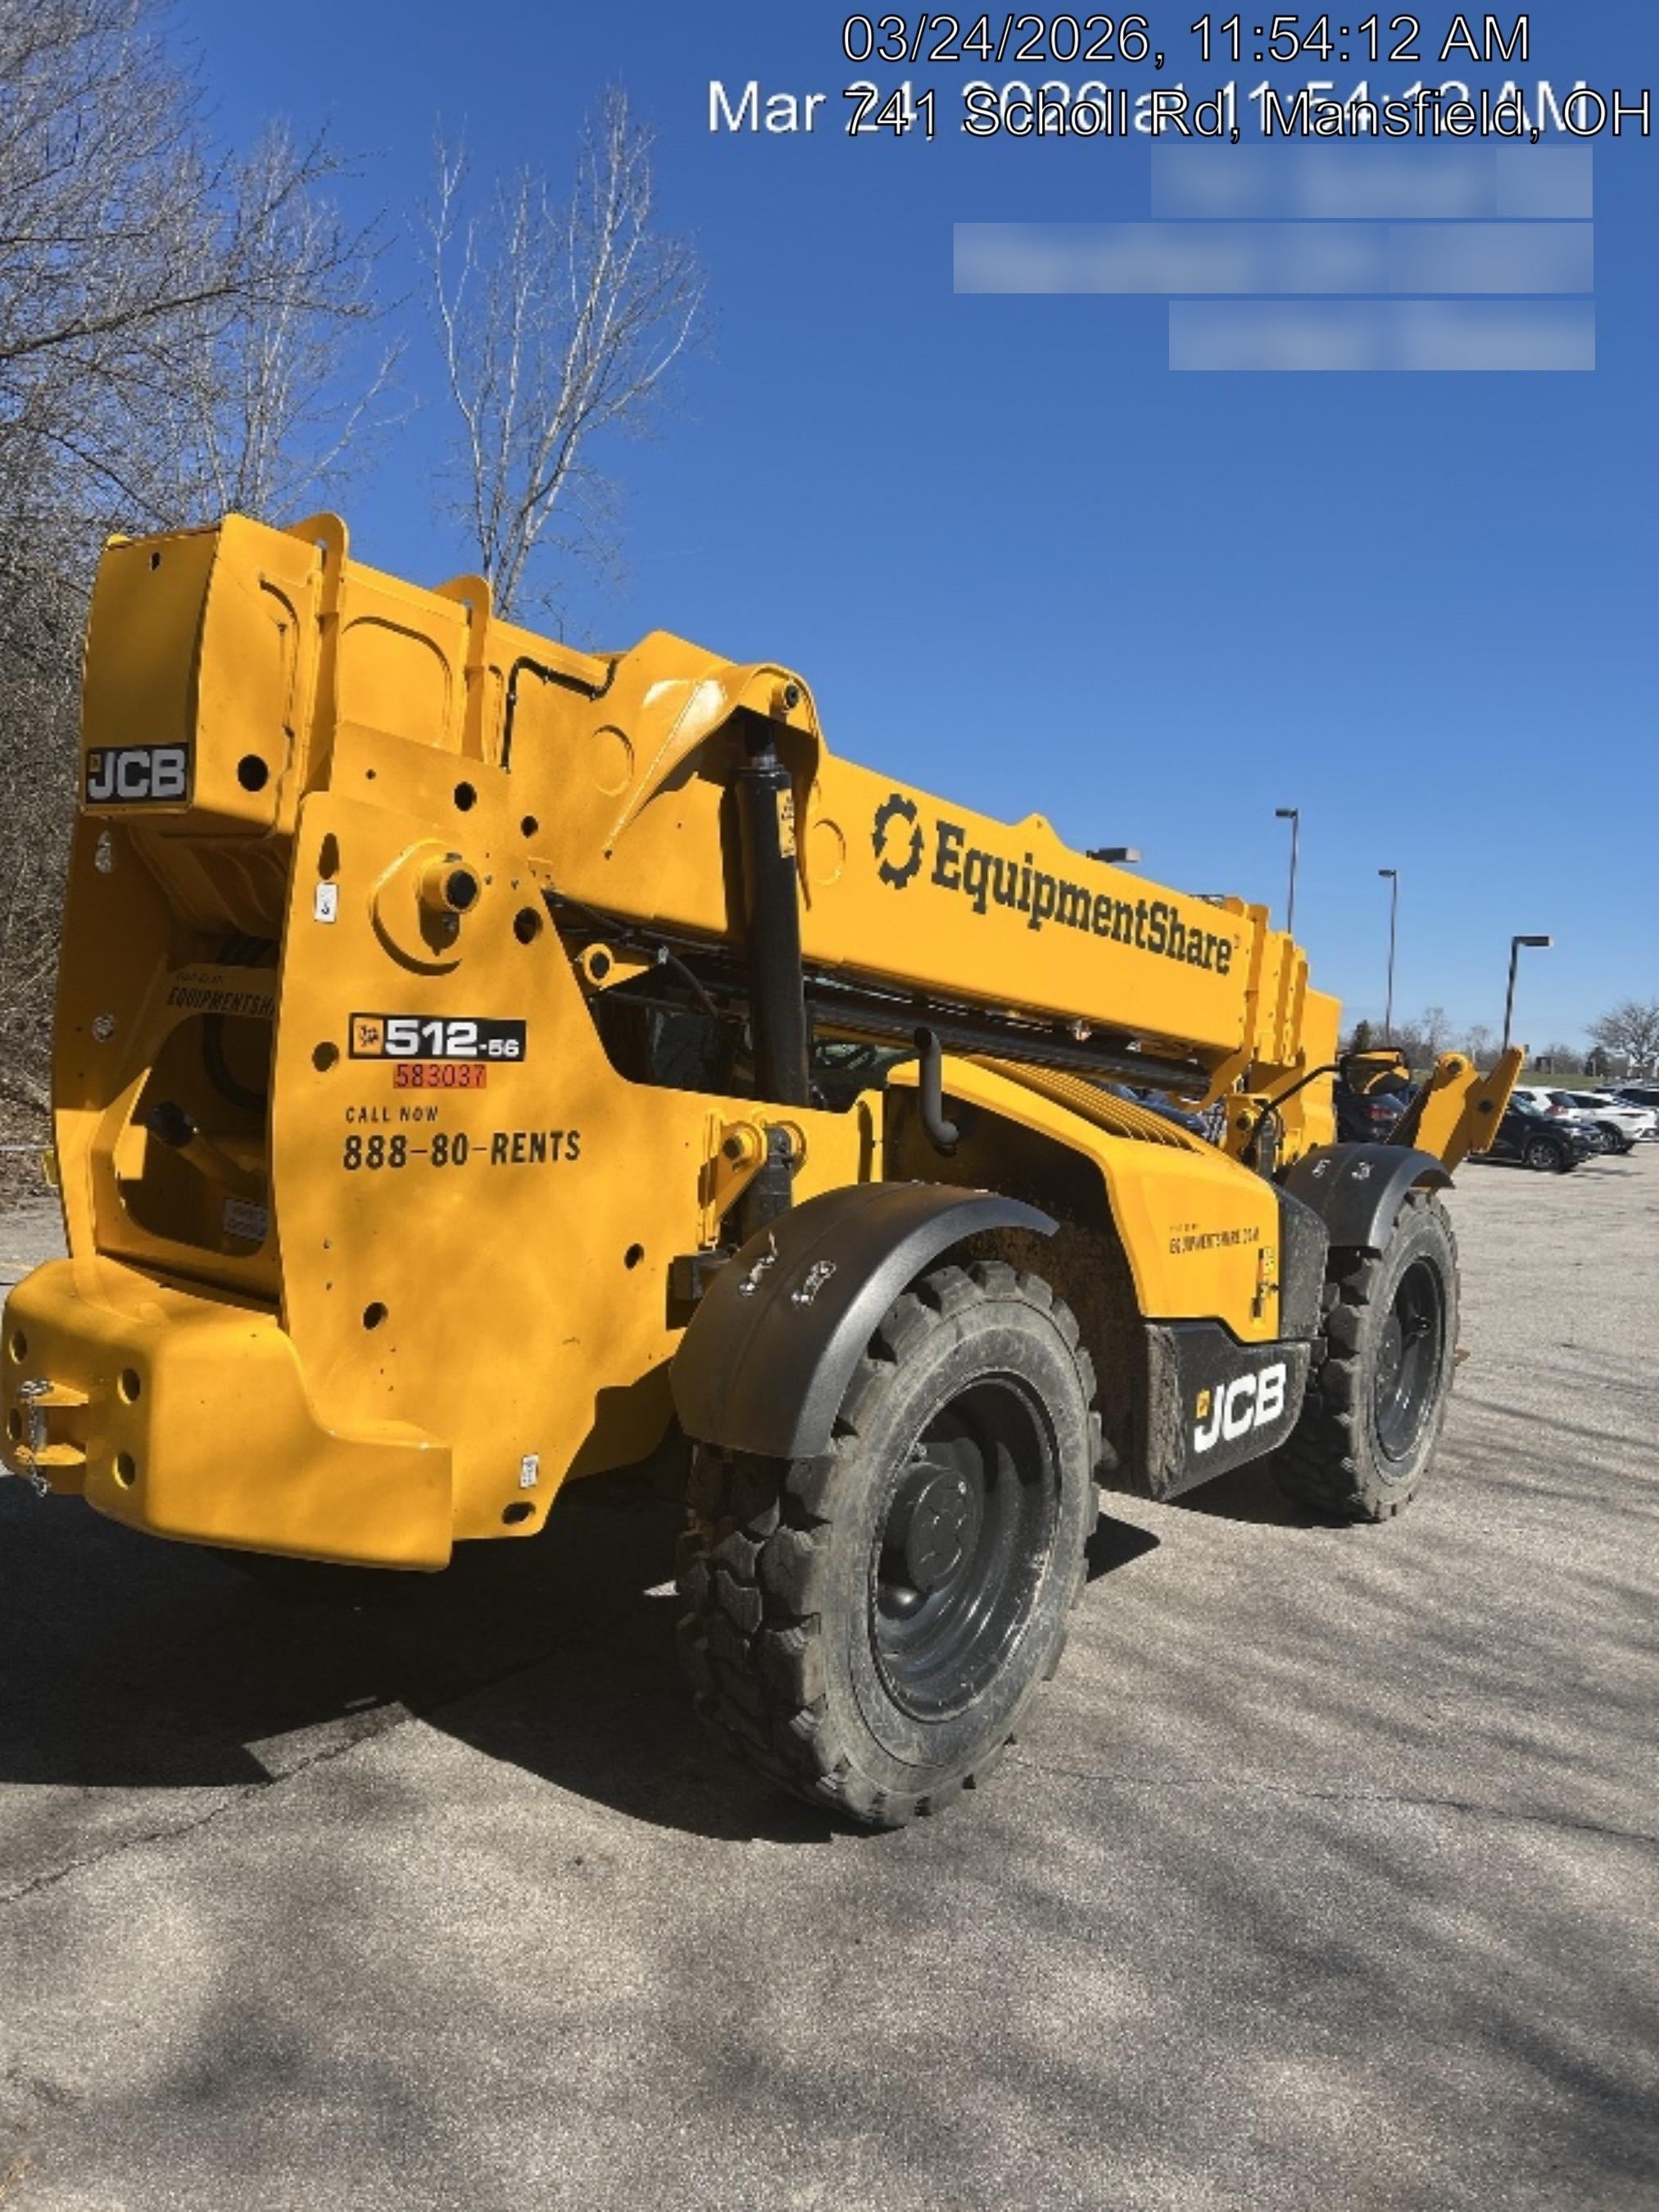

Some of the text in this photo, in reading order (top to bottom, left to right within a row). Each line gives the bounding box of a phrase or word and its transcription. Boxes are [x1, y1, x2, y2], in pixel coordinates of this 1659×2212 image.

[88, 749, 186, 798] JCB
[931, 820, 1231, 976] EquipmentShare
[384, 1019, 519, 1058] 512-56
[397, 1063, 486, 1088] 583037
[345, 1105, 439, 1123] CALL NOW
[342, 1130, 582, 1171] 888-80-RENTS
[1194, 1362, 1287, 1453] JCB
